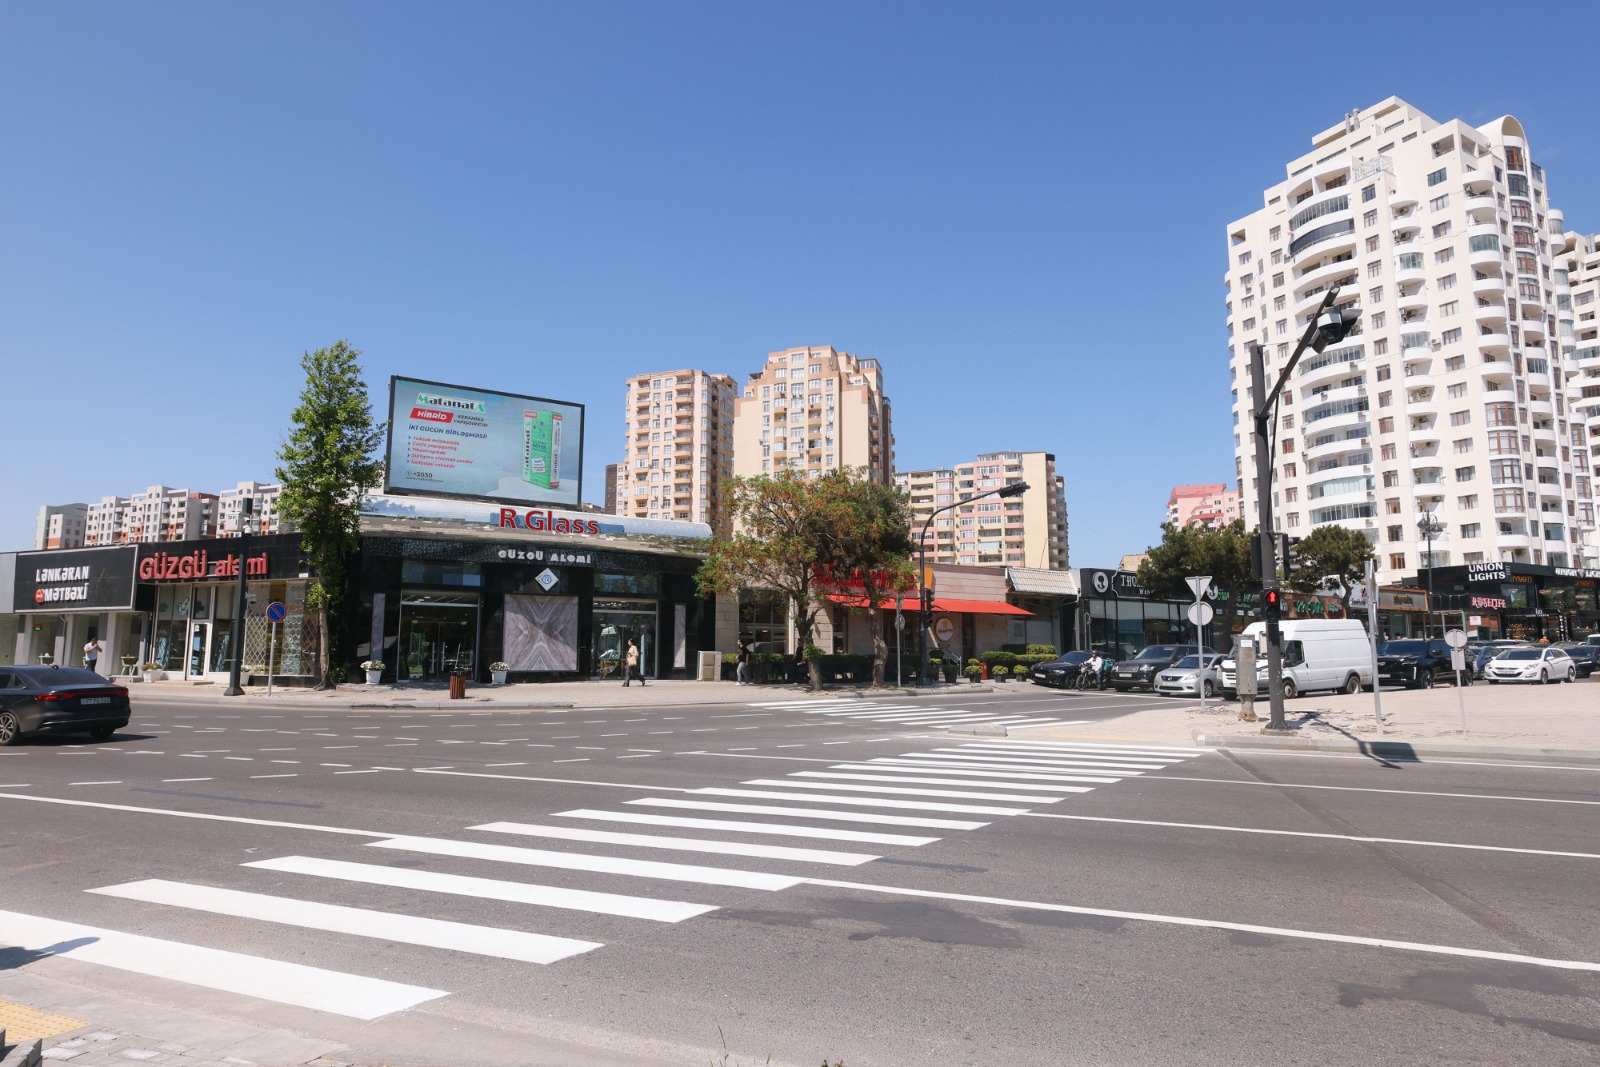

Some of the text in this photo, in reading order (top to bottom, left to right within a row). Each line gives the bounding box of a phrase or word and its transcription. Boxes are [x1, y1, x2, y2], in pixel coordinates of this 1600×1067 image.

[417, 410, 448, 421] HİBRİD
[499, 507, 599, 535] R Glass
[139, 550, 207, 580] GÜZGÜ
[1468, 562, 1504, 573] UNION
[35, 566, 90, 582] LƏNKƏRAN
[1468, 571, 1506, 582] LIGHTS
[44, 583, 90, 602] MƏTBƏXİ
